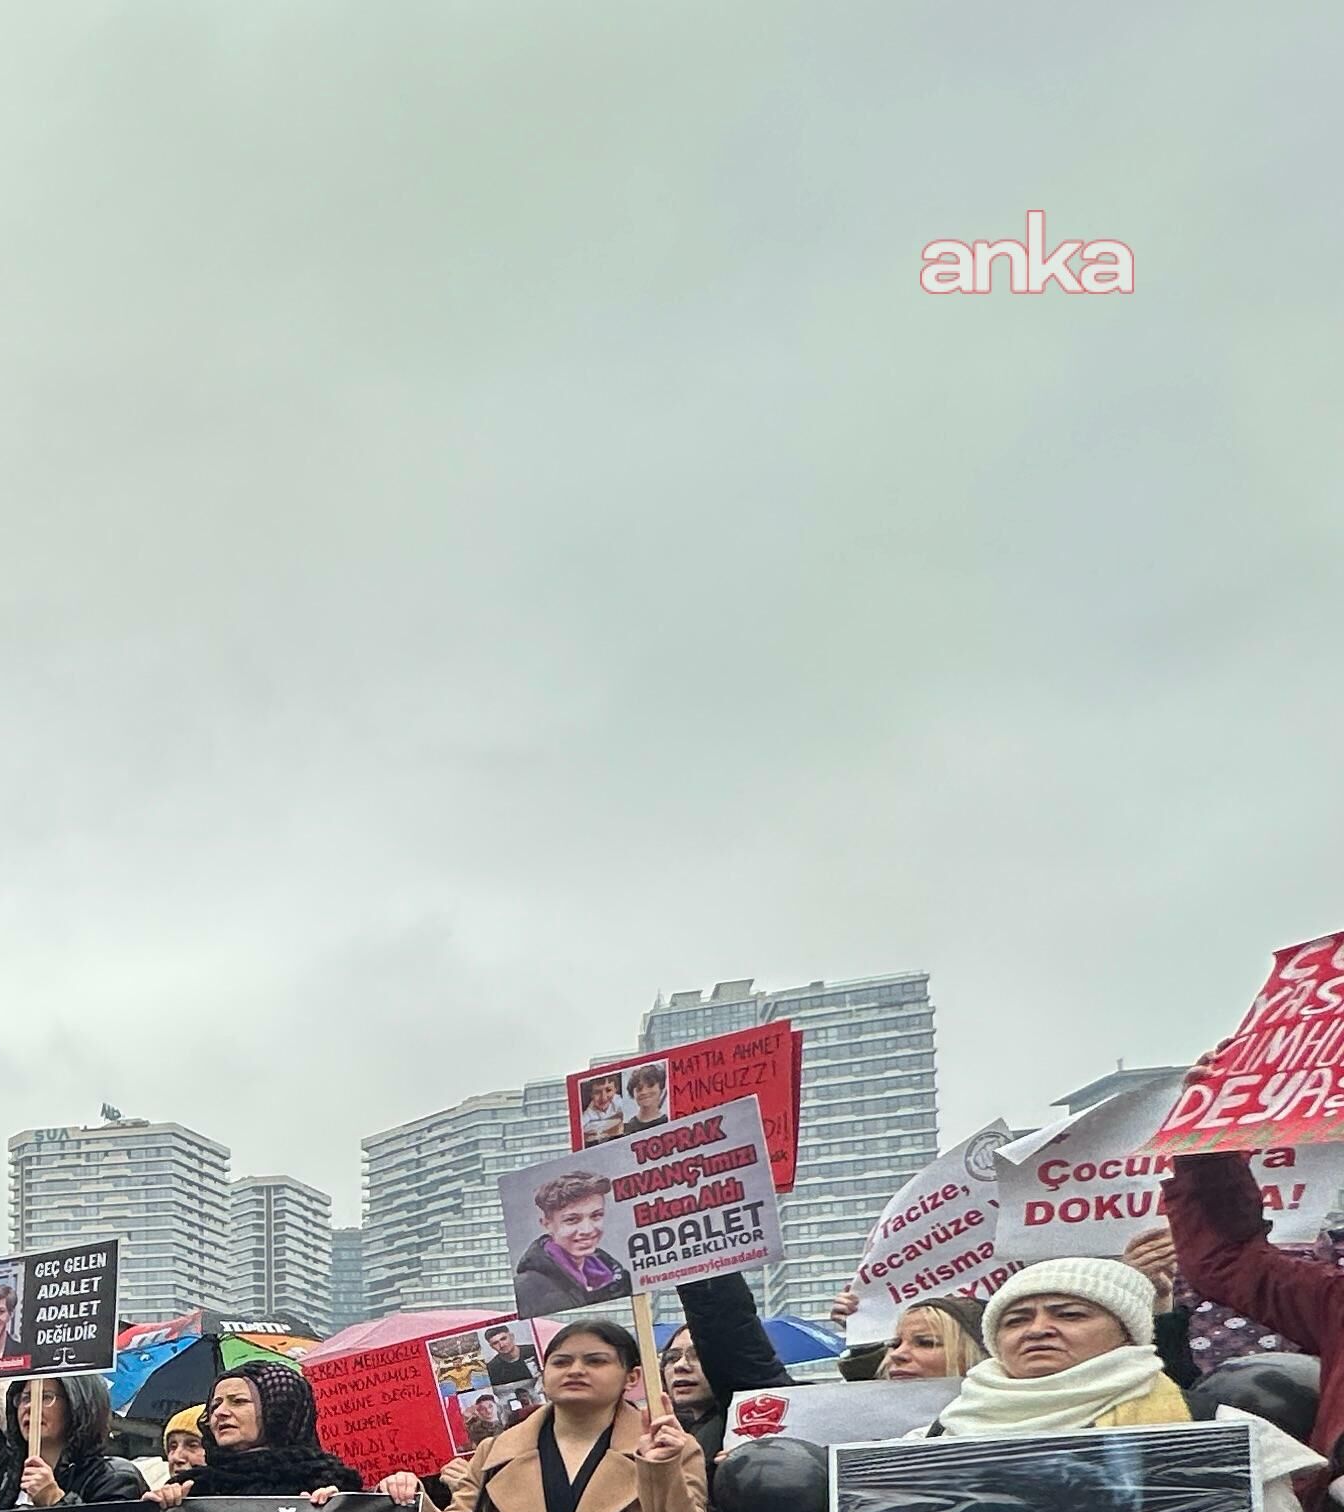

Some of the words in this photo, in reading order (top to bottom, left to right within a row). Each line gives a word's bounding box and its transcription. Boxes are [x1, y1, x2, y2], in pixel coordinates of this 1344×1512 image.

[732, 1033, 784, 1059] AHMET
[631, 1115, 727, 1164] TOPRAK
[633, 1194, 699, 1228] Erken
[696, 1177, 745, 1209] Aldı
[880, 1182, 970, 1240] Tacize,
[628, 1201, 764, 1259] ADALET
[632, 1251, 678, 1272] HALA
[682, 1229, 764, 1259] BEKLİYOR
[859, 1208, 985, 1285] Tecavüze
[35, 1260, 61, 1279] GEÇ
[64, 1252, 107, 1273] GELEN
[37, 1276, 102, 1300] ADALET
[886, 1240, 995, 1305] İstisma
[36, 1300, 101, 1323] ADALET
[37, 1321, 97, 1345] DEĞİLDİR
